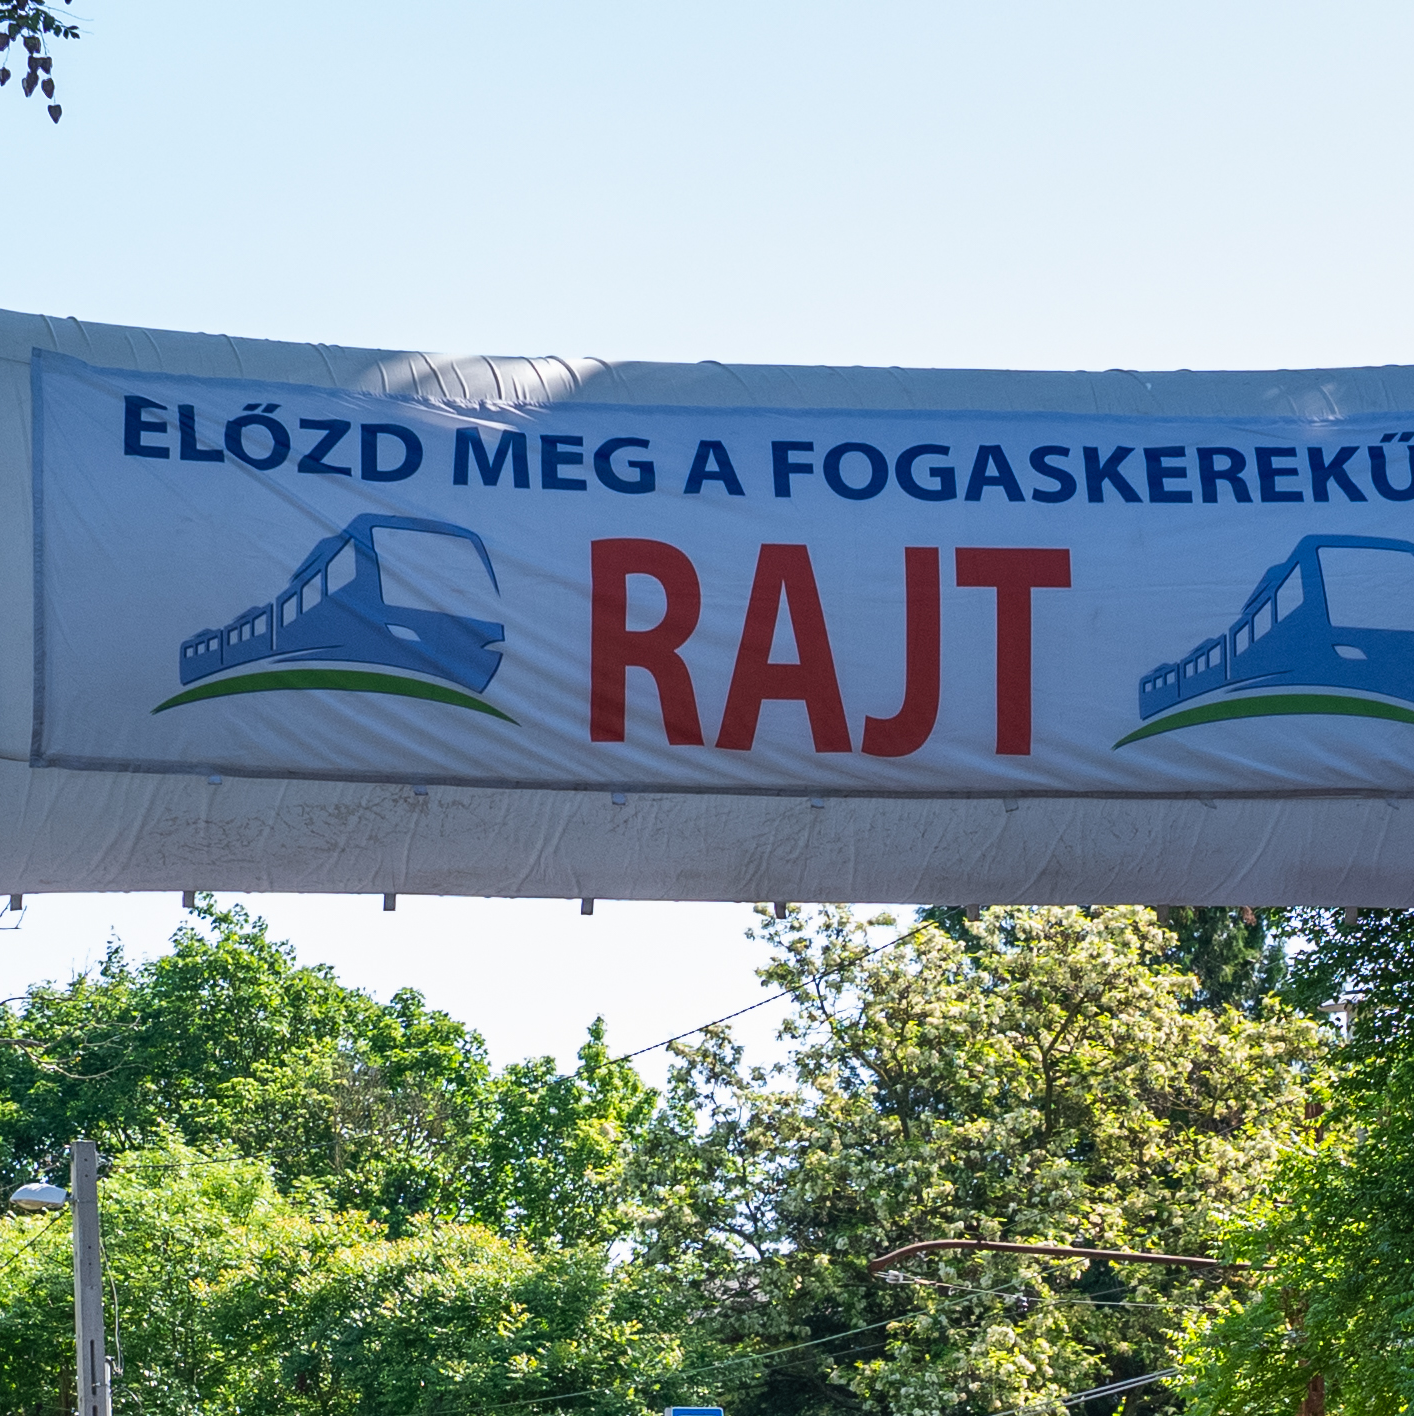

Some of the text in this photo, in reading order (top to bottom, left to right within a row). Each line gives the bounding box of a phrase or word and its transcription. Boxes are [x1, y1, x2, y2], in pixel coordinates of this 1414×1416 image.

[122, 394, 424, 483] ELŐZD
[452, 426, 656, 495] MEG
[682, 439, 746, 497] A
[588, 537, 1073, 758] RAJT
